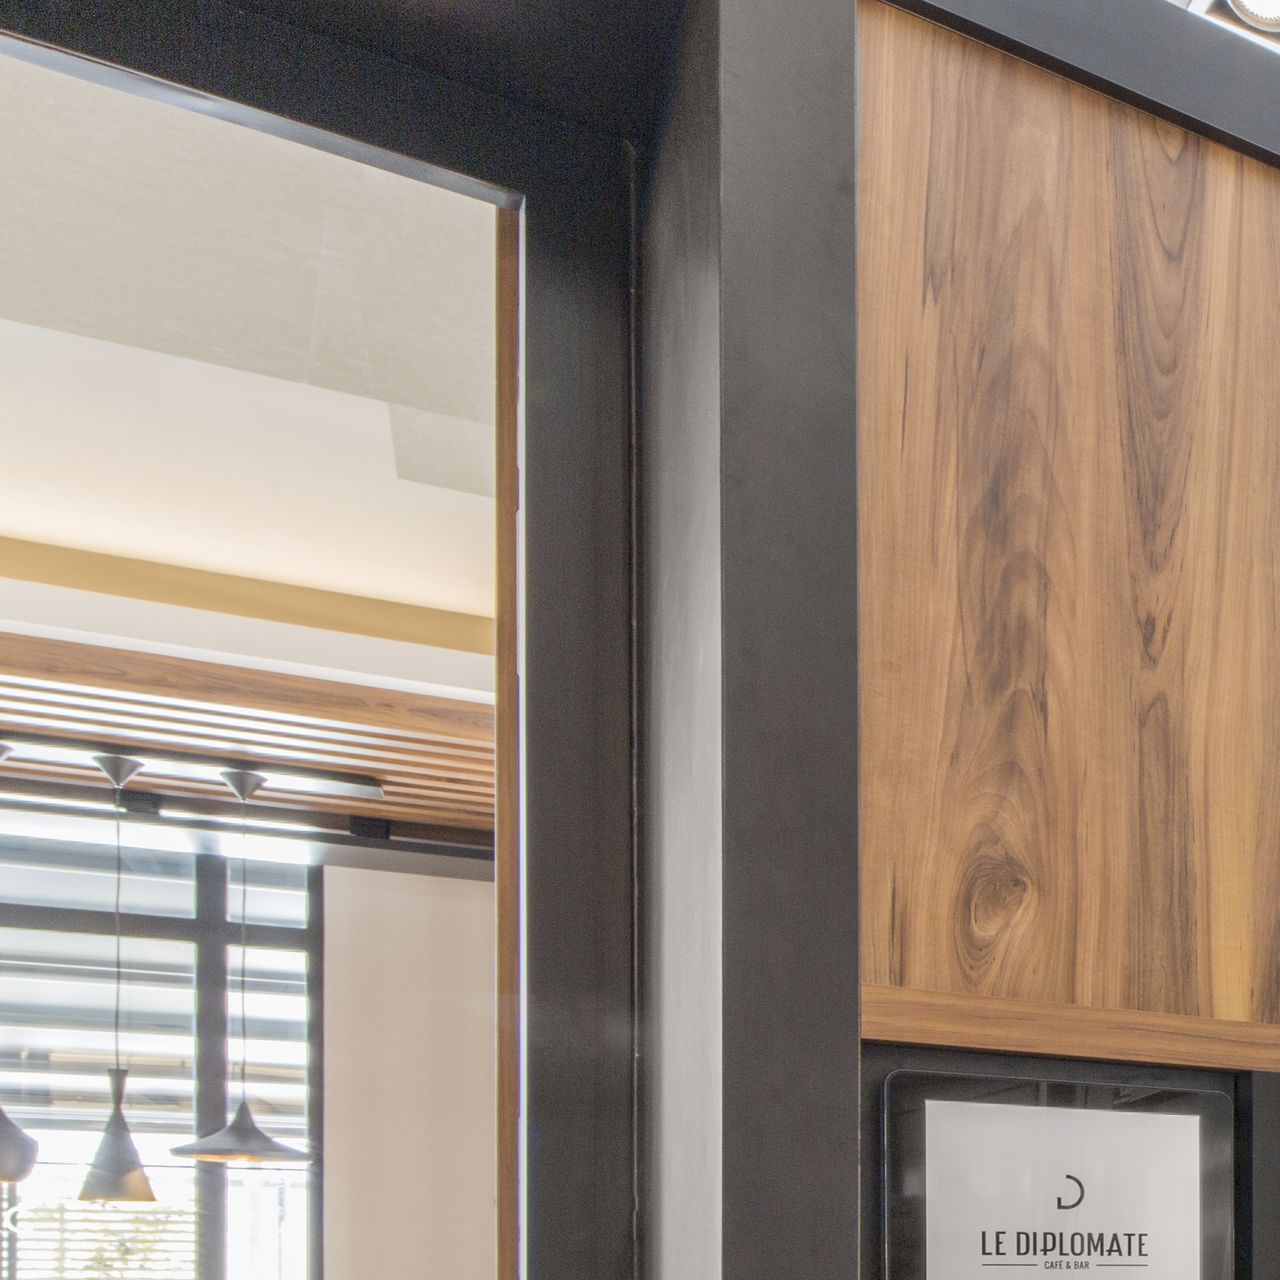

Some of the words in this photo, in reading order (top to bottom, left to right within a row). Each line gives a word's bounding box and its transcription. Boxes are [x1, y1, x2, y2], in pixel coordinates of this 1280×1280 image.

[981, 1231, 1007, 1256] LE
[1016, 1231, 1149, 1257] DIPLOMATE
[1044, 1260, 1063, 1270] CAFÉ
[1065, 1261, 1072, 1270] &
[1073, 1261, 1090, 1270] BAR
